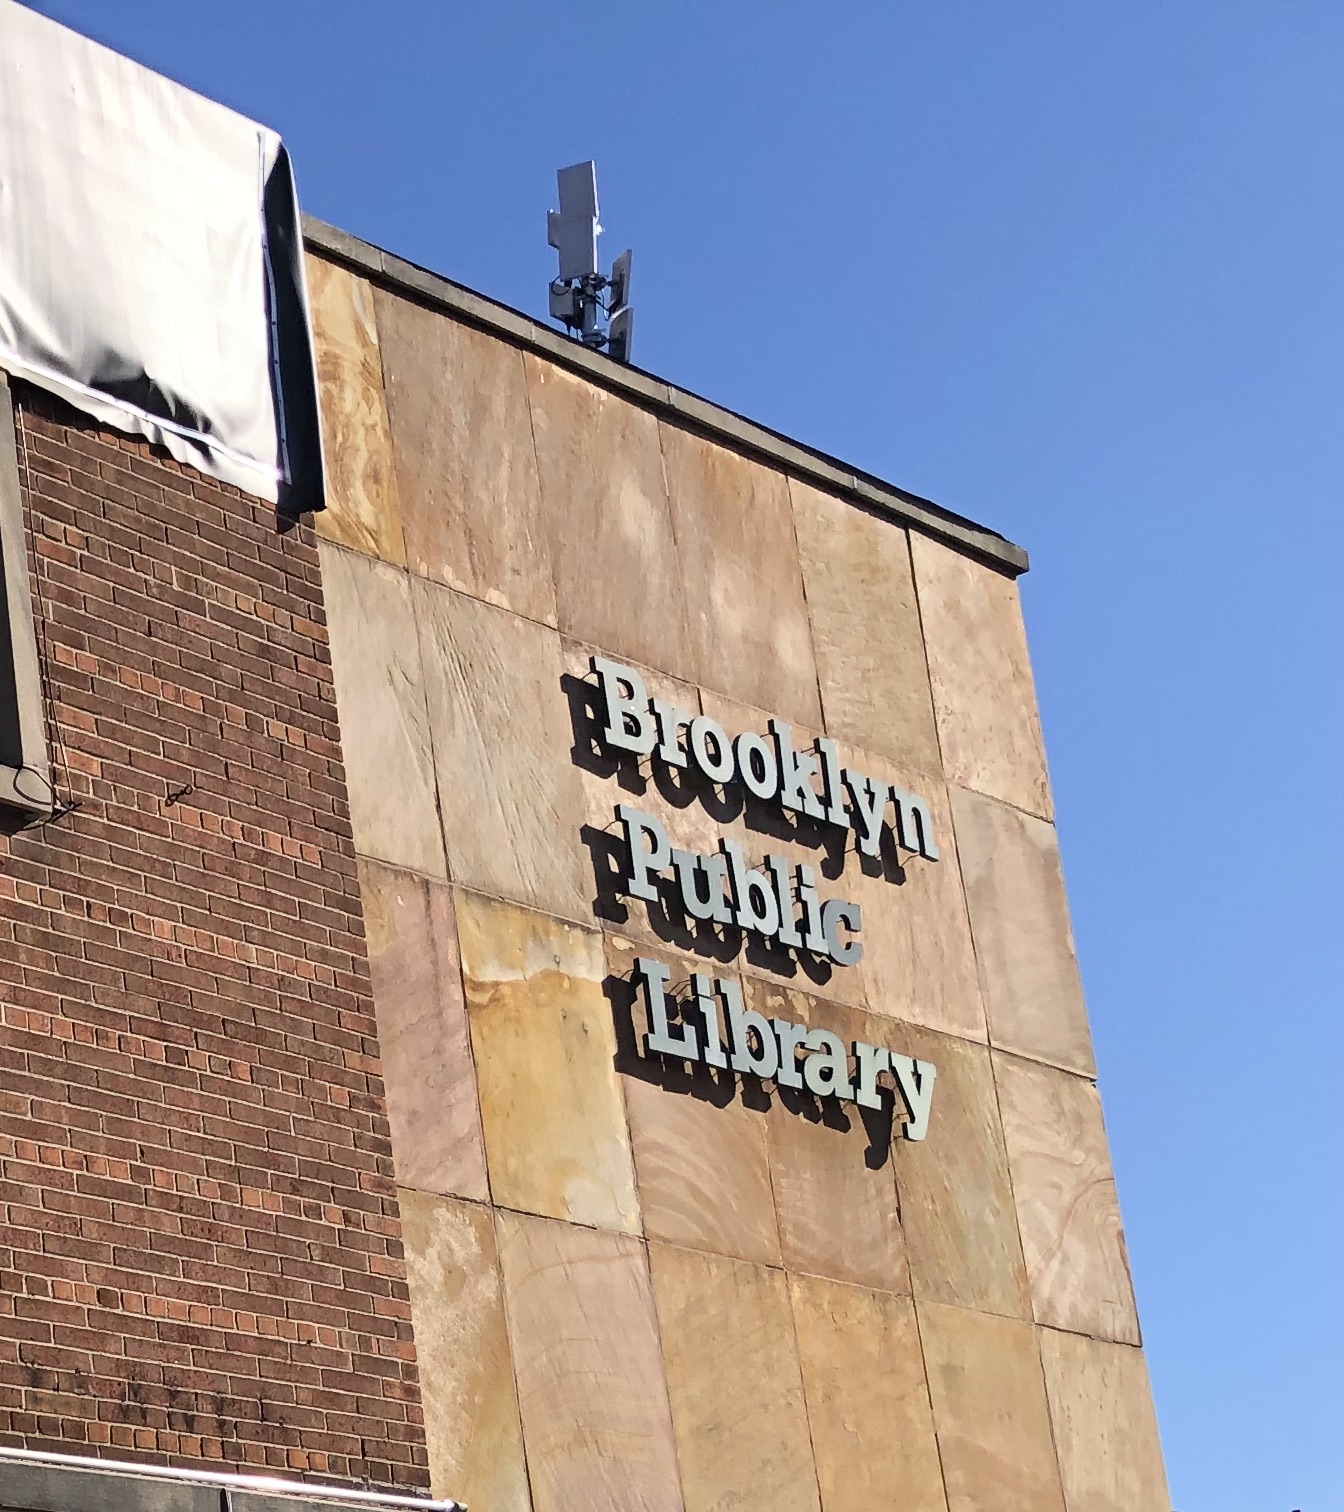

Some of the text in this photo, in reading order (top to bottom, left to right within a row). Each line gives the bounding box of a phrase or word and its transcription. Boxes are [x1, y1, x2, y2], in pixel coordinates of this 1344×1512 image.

[590, 656, 939, 861] Brooklyn
[614, 804, 862, 967] Public
[634, 957, 937, 1141] Library
